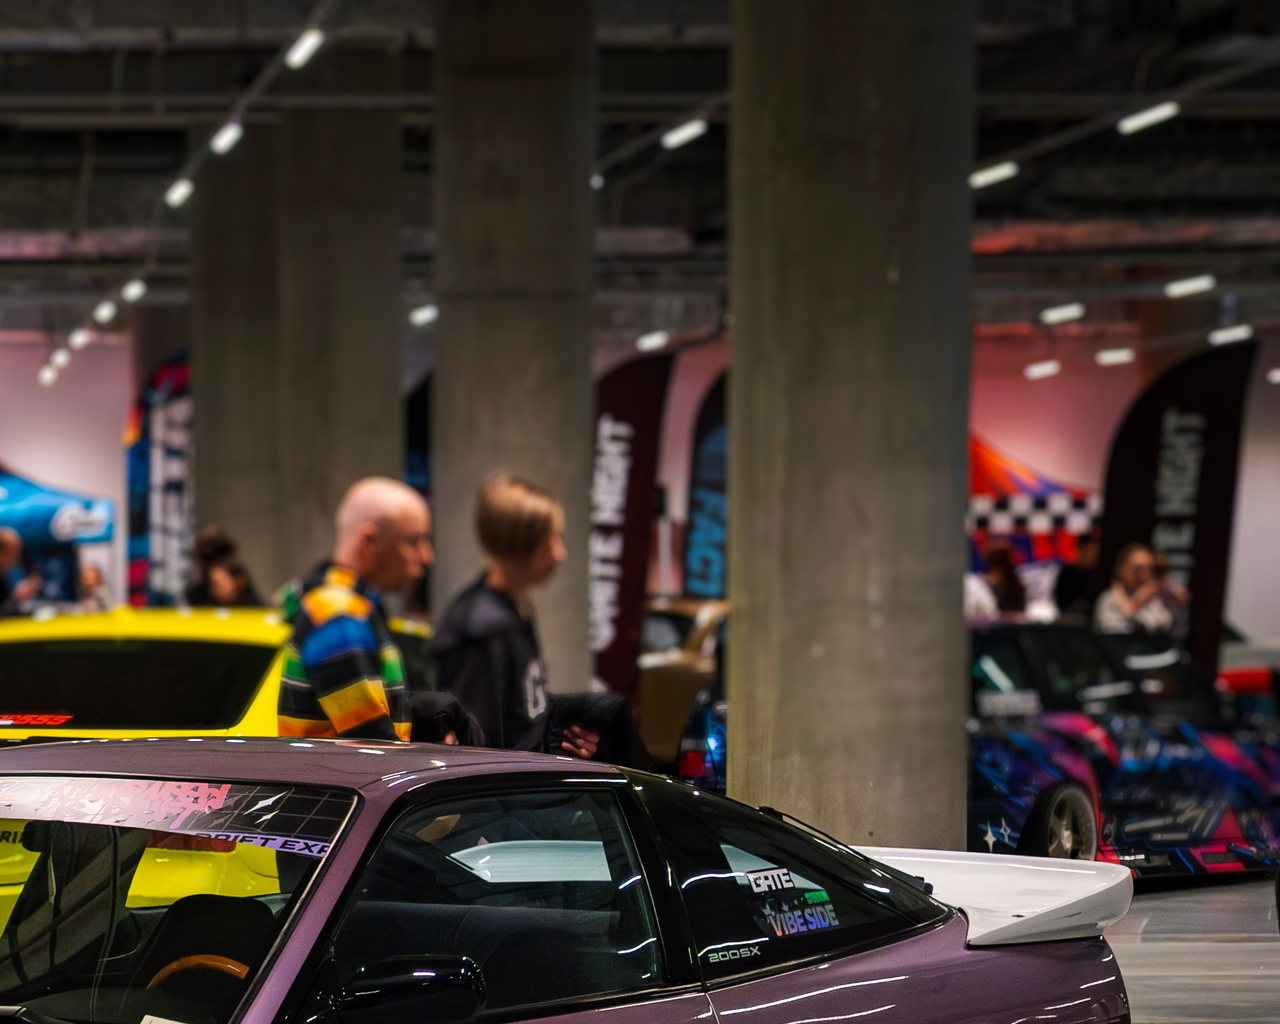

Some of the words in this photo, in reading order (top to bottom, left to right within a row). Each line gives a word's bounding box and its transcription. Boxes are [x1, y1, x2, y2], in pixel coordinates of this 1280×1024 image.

[747, 868, 794, 893] GATE
[768, 909, 807, 937] VIBE
[805, 904, 839, 930] SIDE
[708, 946, 761, 963] 200SX
